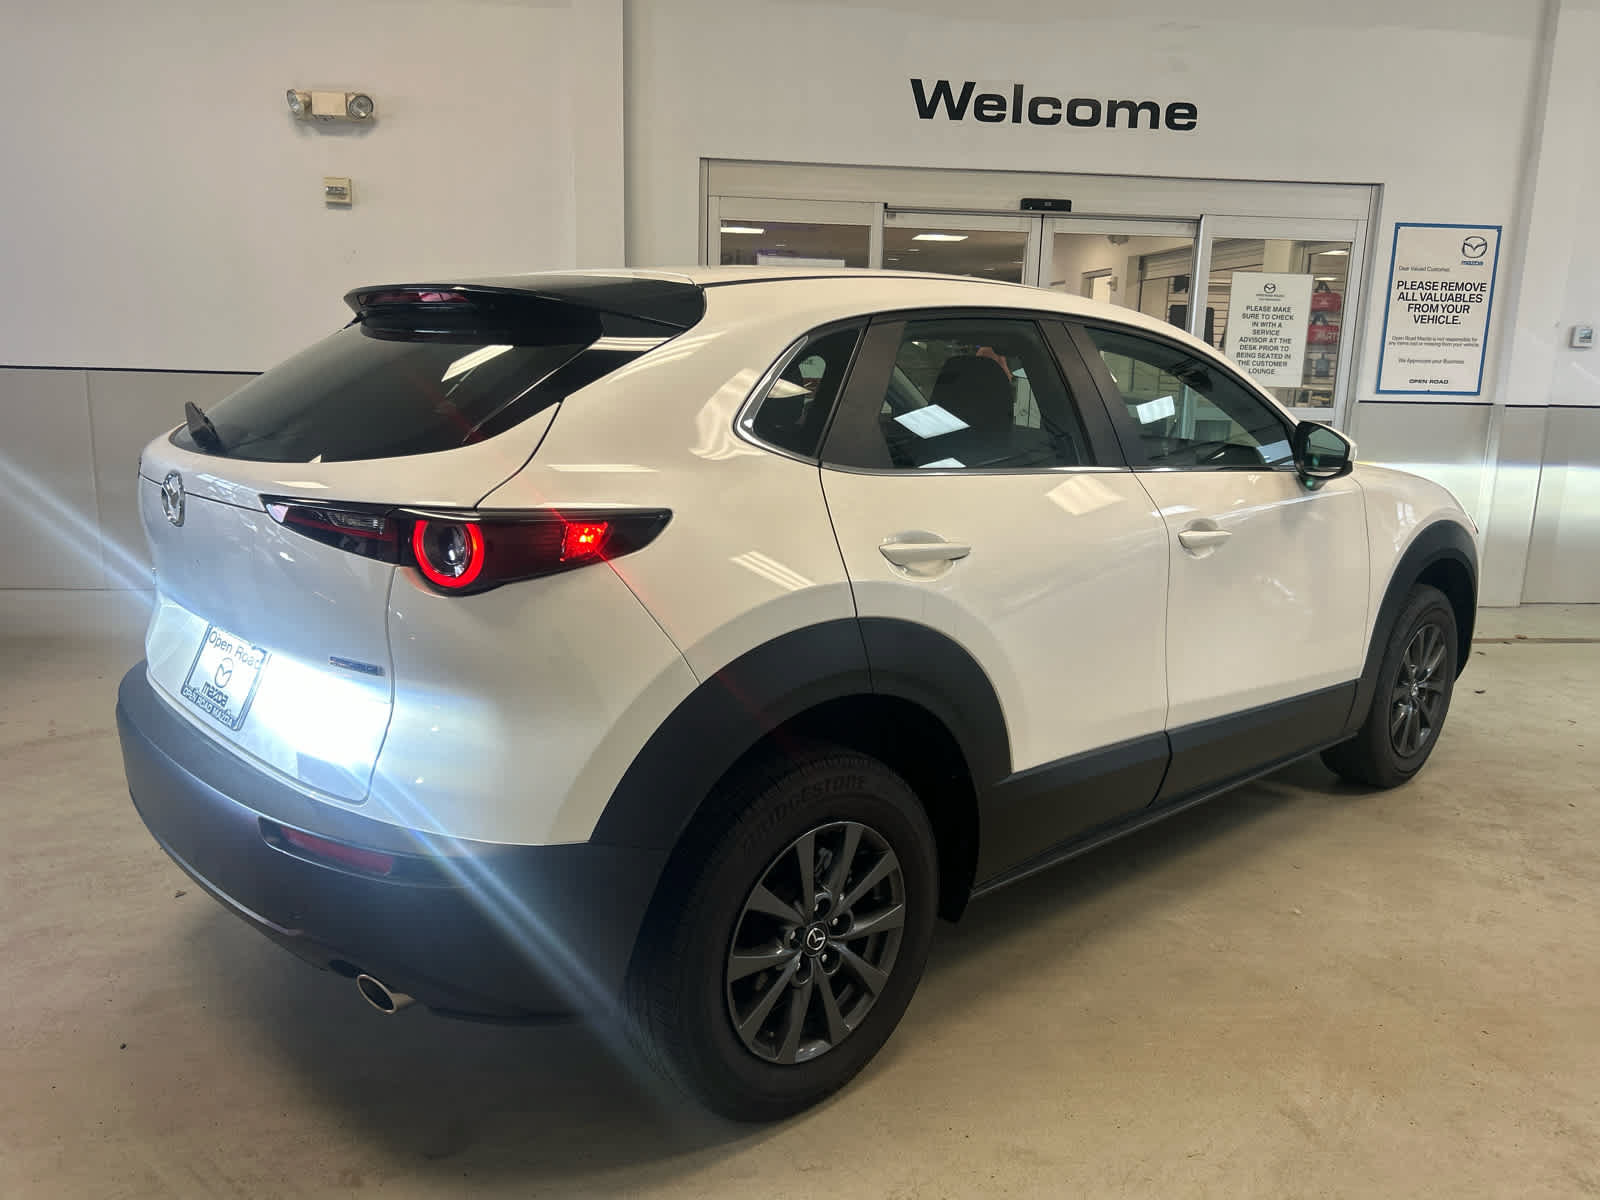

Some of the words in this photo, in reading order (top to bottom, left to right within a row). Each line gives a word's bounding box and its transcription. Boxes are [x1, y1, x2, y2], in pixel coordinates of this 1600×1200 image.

[910, 78, 1197, 130] Welcome
[1397, 280, 1439, 291] PLEASE
[1440, 282, 1487, 292] REMOVE
[1397, 291, 1417, 302] ALL
[1420, 292, 1483, 303] VALUABLES
[1246, 305, 1272, 313] PLEASE
[1407, 303, 1439, 314] FROM
[1440, 304, 1470, 314] YOUR
[1413, 314, 1461, 325] VEHICLE.
[209, 631, 233, 653] Open
